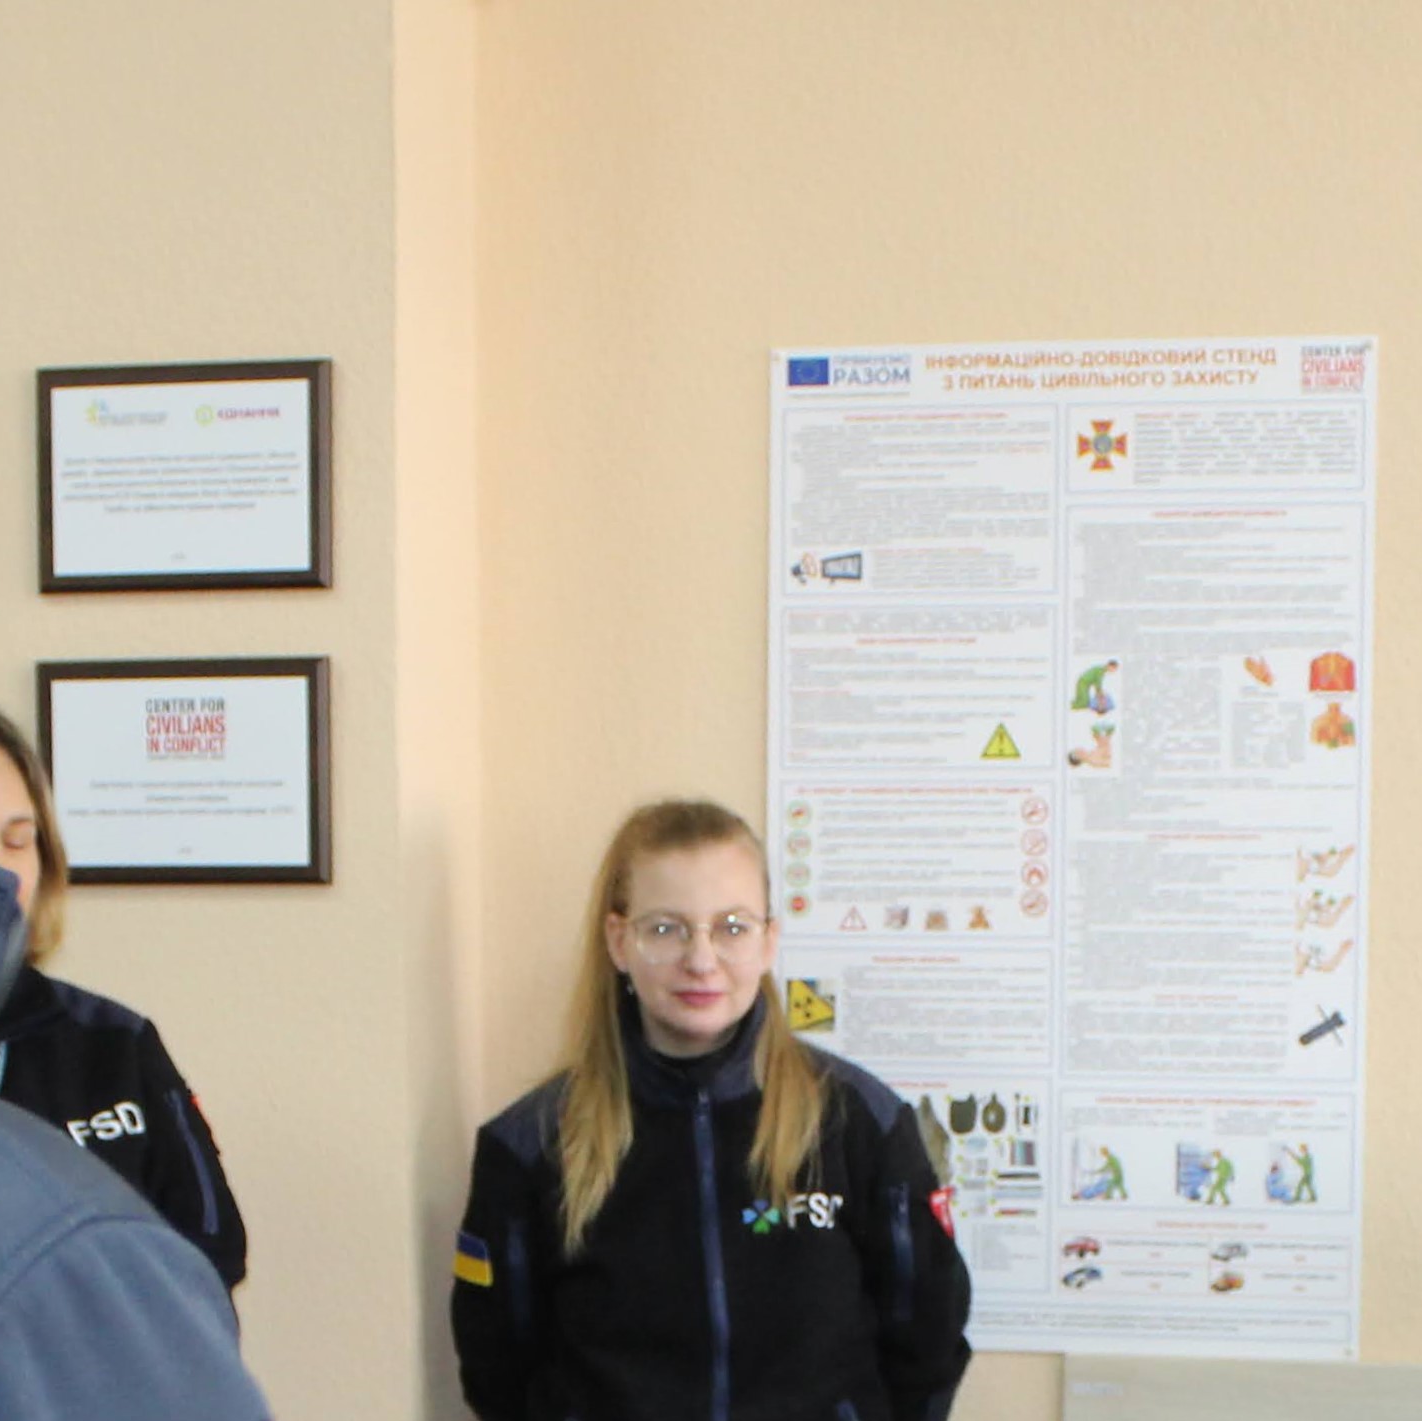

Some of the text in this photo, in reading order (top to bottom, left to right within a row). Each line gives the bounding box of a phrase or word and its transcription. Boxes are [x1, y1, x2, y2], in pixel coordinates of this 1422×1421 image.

[1212, 348, 1277, 366] СТЕНД
[833, 367, 911, 385] РАЗОМ
[943, 369, 1259, 391] З ПИТАНЬ ЦИВІЛЬНОГО ЗАХИСТУ
[145, 698, 225, 713] CENTER FOR
[145, 715, 226, 735] CIVILIANS
[147, 737, 225, 753] IN CONFLICT
[66, 1100, 147, 1147] FSD
